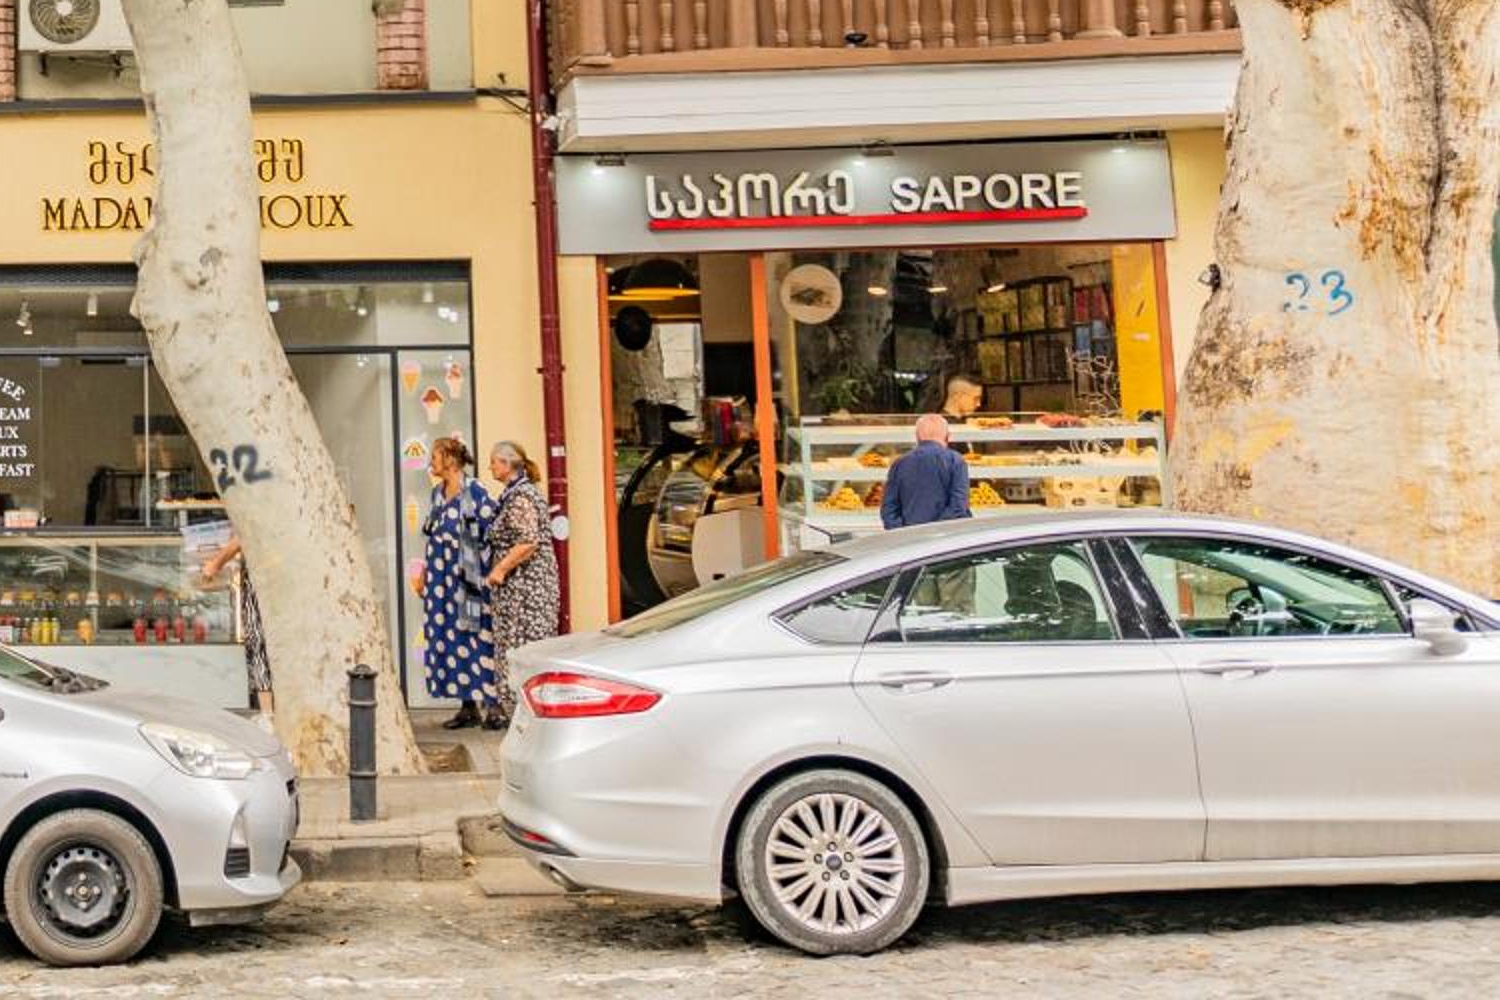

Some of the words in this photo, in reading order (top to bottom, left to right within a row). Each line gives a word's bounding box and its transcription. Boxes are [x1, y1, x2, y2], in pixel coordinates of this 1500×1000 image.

[258, 194, 354, 229] OUX
[645, 169, 855, 219] საპორე
[890, 170, 1086, 213] SAPORE
[1283, 269, 1353, 316] 23
